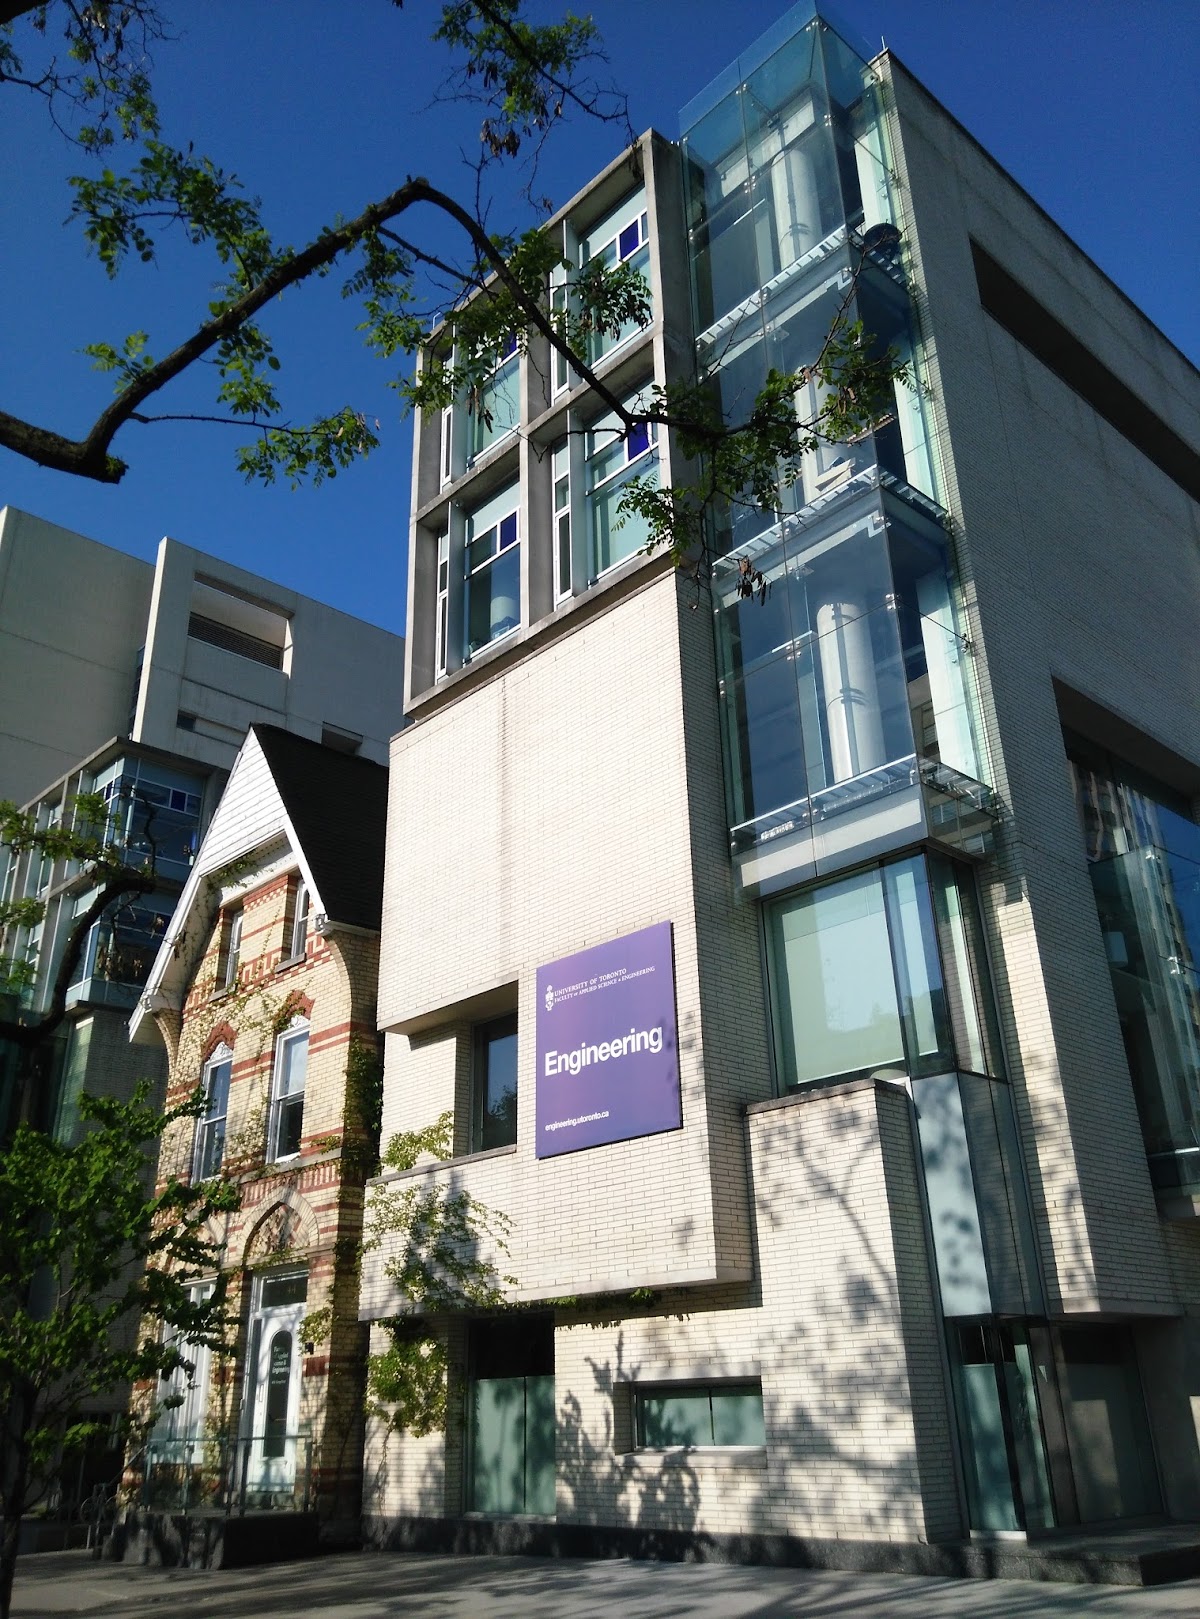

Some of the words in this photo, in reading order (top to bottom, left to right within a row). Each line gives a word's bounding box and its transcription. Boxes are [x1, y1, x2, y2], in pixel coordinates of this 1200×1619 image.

[554, 981, 588, 997] UNIVERSITY
[589, 977, 598, 985] OF
[599, 968, 627, 982] TORONTO
[554, 992, 574, 1003] FACULTY
[579, 985, 598, 996] APPLIED
[598, 978, 617, 989] SCIENCE
[622, 965, 656, 981] ENGINEERING
[545, 1027, 662, 1077] Engineering
[544, 1110, 610, 1131] engineering.utoronto.ca
